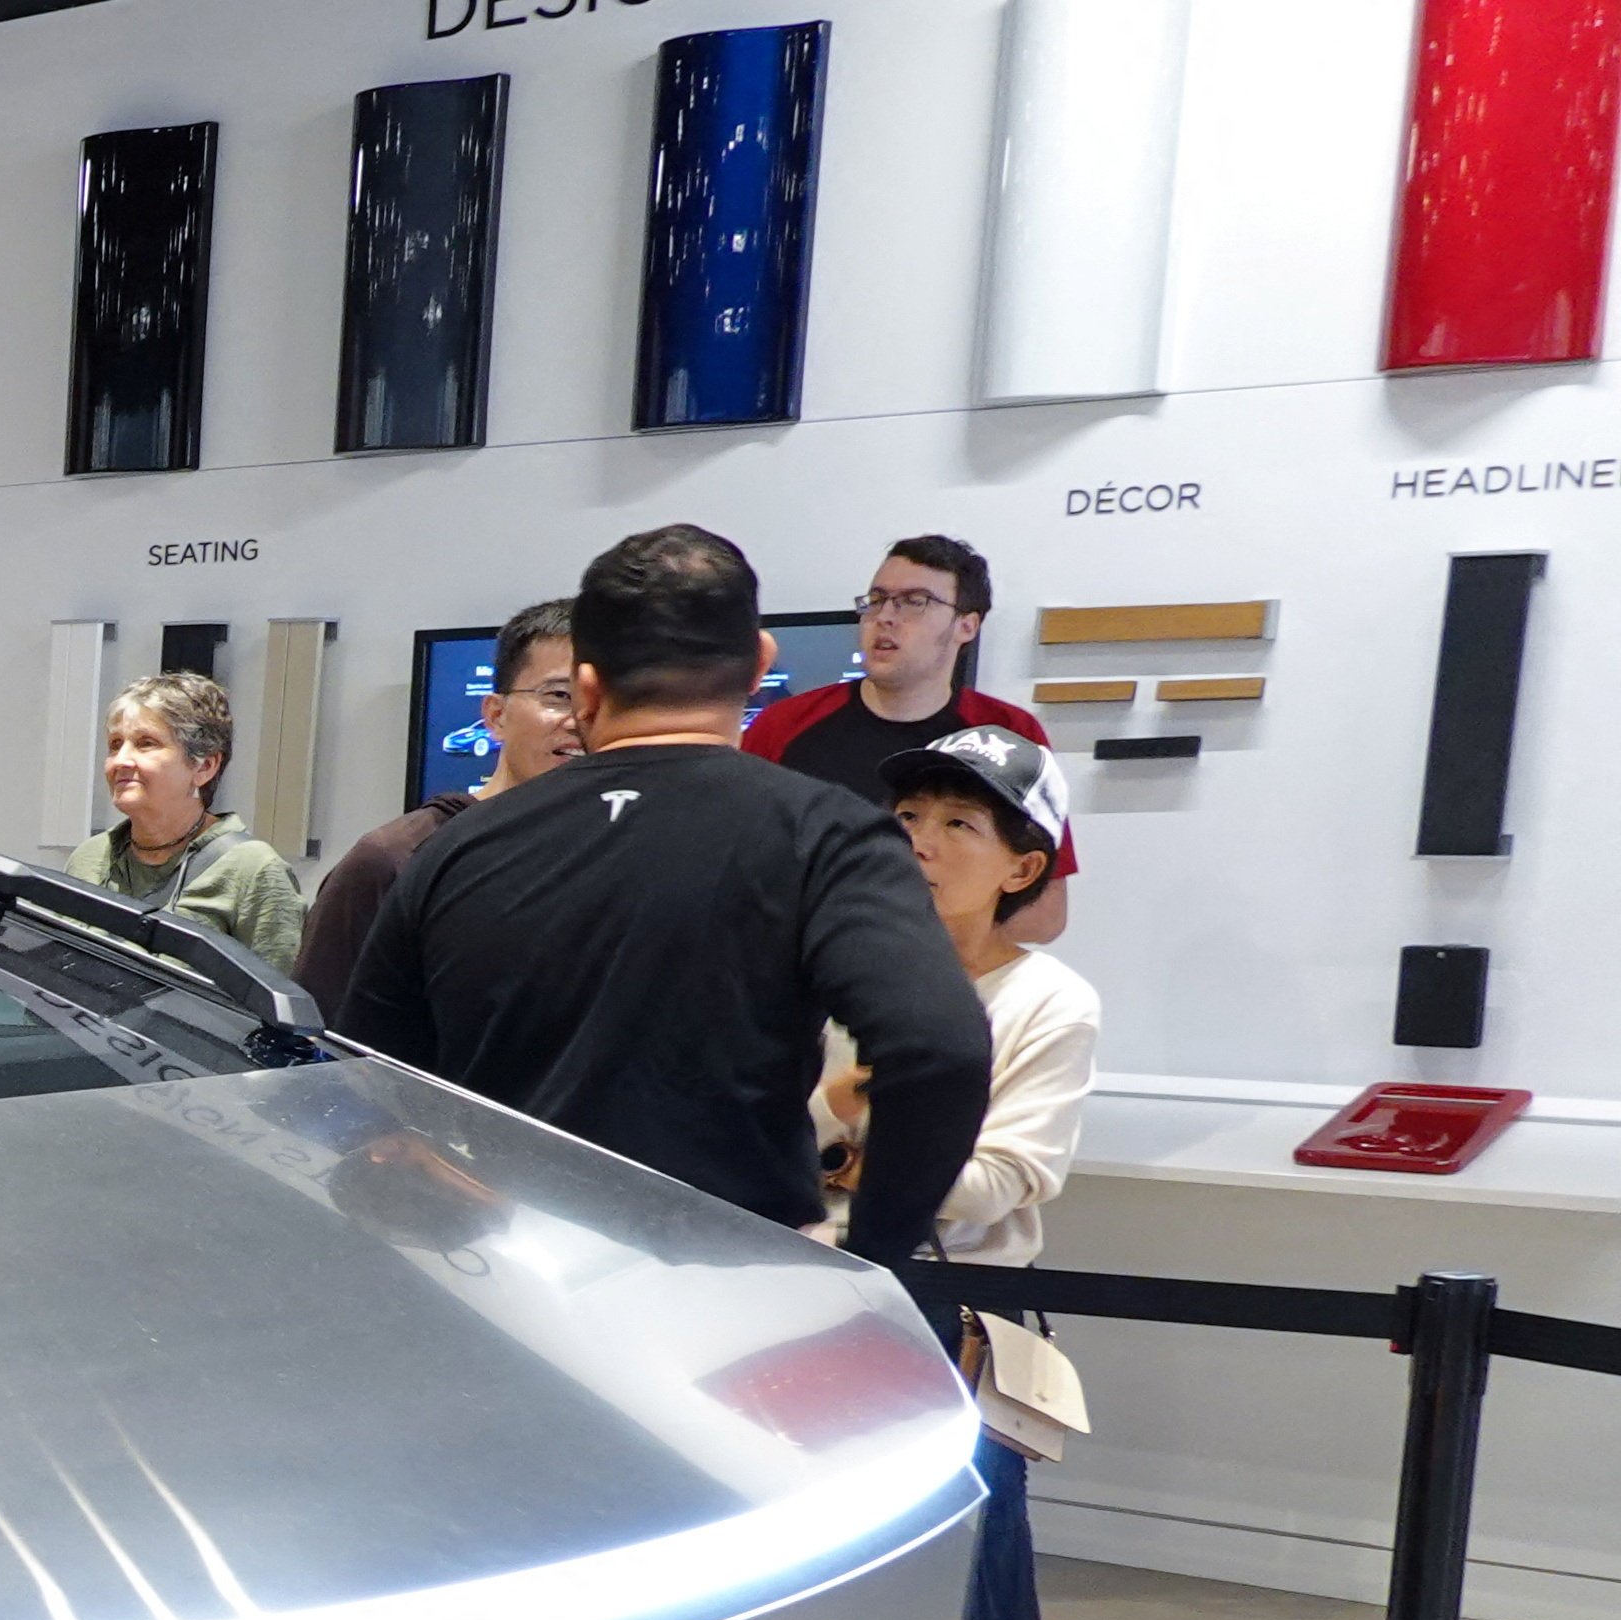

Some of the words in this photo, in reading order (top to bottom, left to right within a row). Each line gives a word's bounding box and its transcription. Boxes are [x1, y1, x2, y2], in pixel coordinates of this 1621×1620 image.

[1391, 458, 1621, 499] HEADLINE
[1066, 481, 1201, 516] DÉCOR
[148, 538, 259, 566] SEATING
